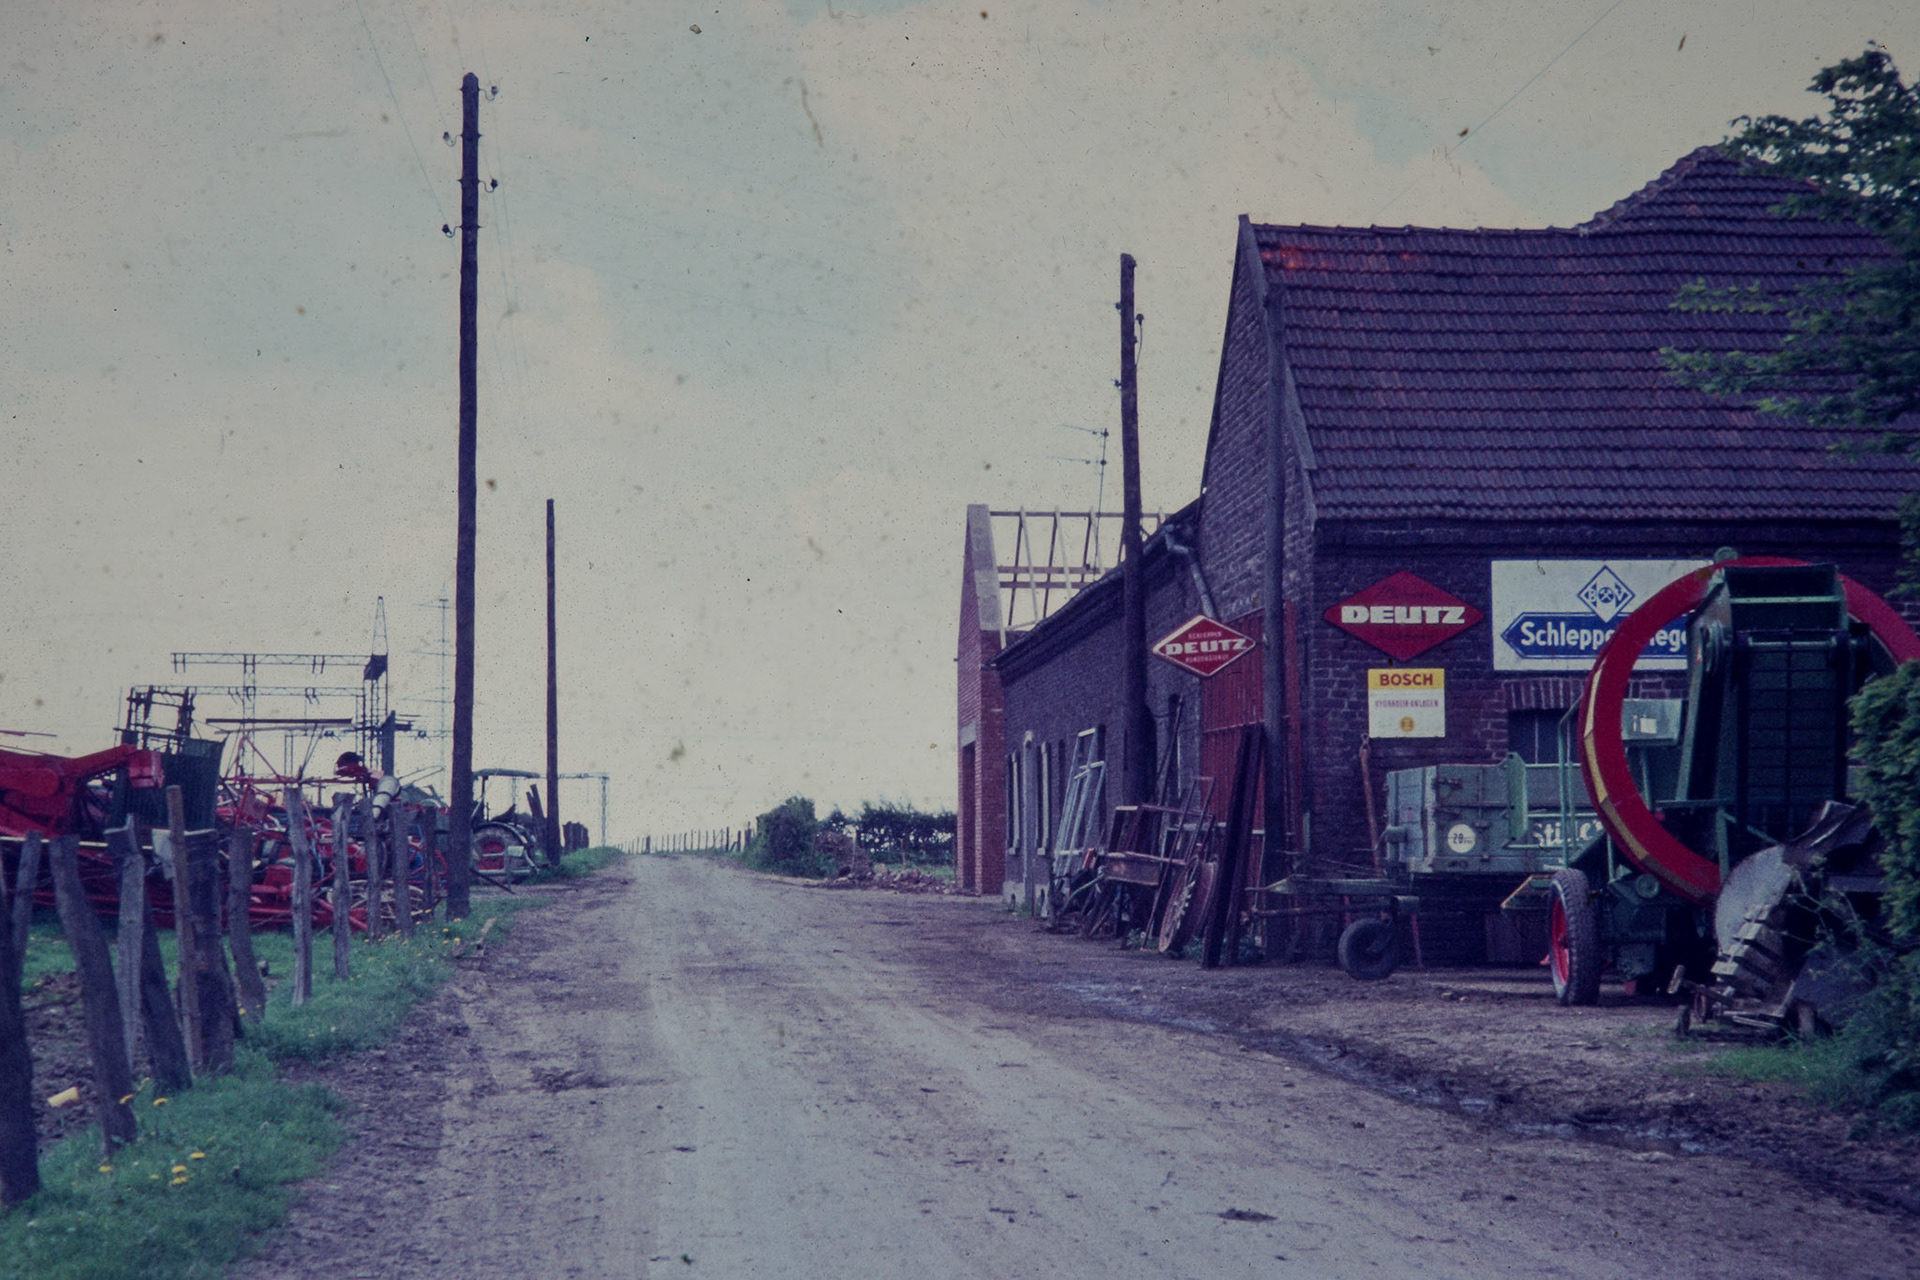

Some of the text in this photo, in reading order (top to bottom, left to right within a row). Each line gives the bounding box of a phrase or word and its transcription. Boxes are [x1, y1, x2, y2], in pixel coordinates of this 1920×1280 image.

[1341, 605, 1465, 624] DEUTZ
[1166, 638, 1248, 655] DEUTZ
[1380, 673, 1433, 686] BOSCH
